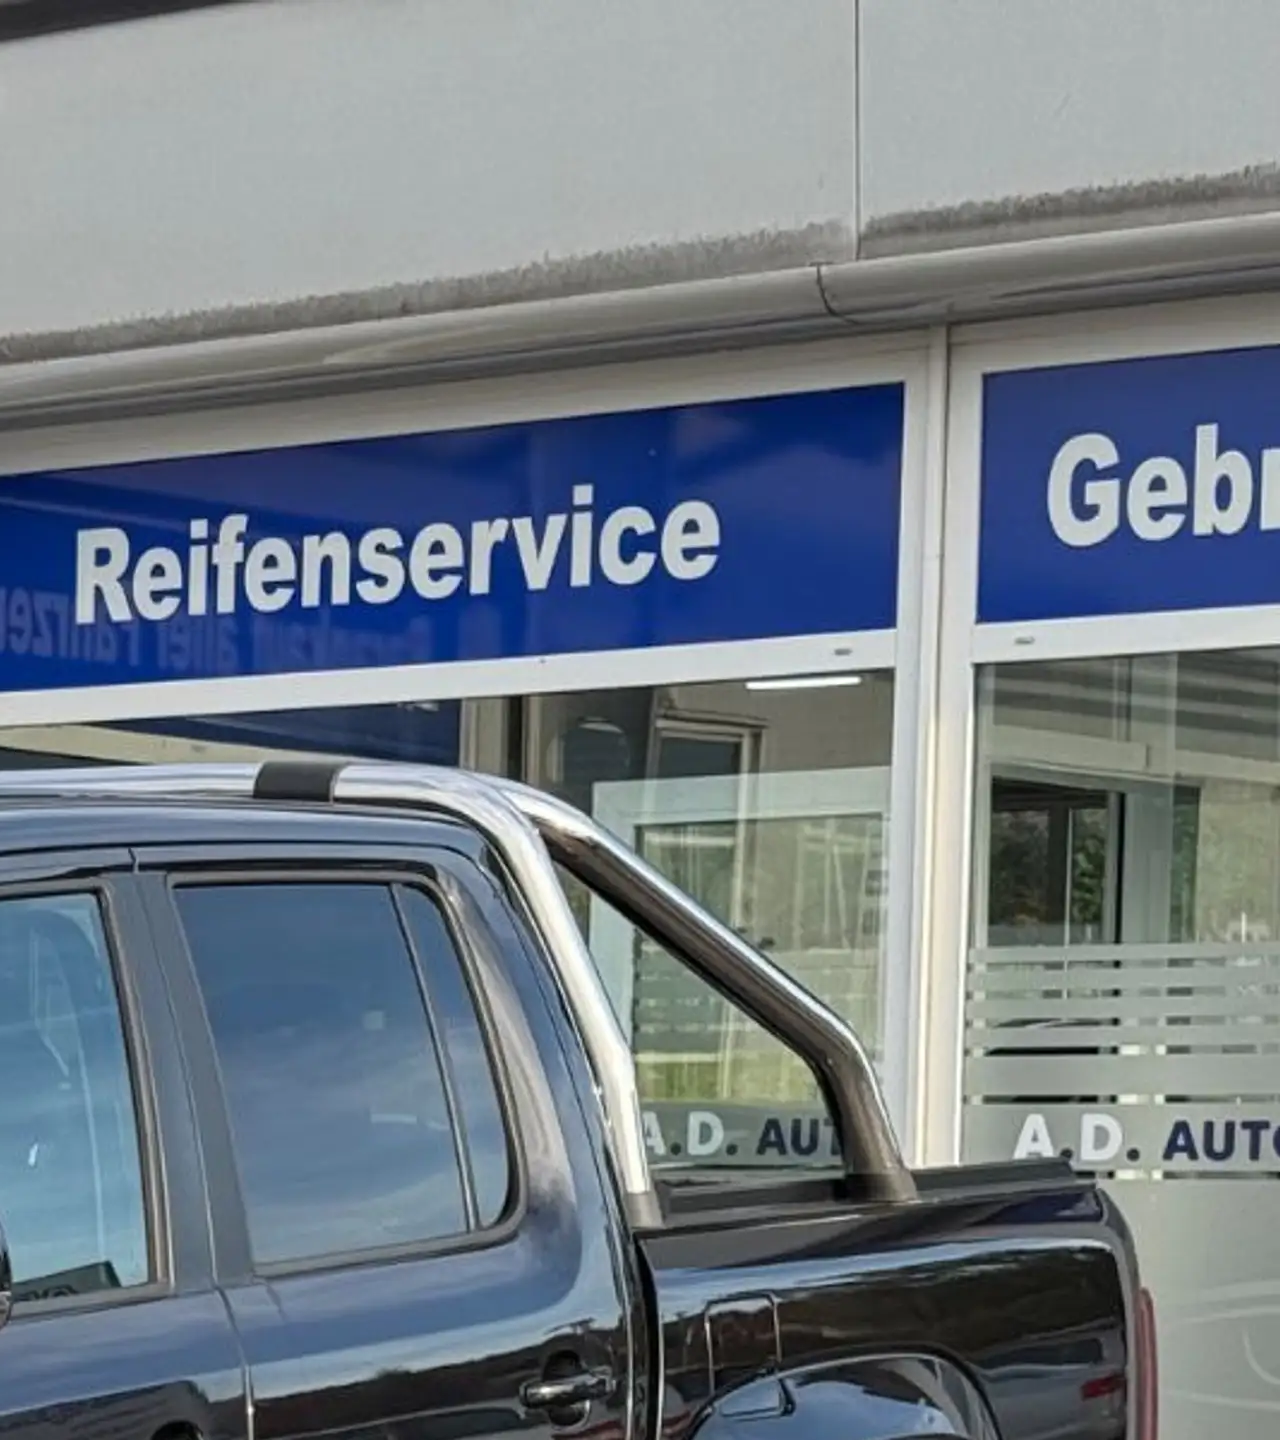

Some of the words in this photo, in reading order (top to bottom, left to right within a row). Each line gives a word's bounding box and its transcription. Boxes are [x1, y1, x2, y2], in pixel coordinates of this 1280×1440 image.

[73, 484, 721, 625] Reifenservice
[643, 1111, 739, 1157] A.D.
[1012, 1112, 1140, 1162] A.D.
[1162, 1119, 1280, 1162] AUT
